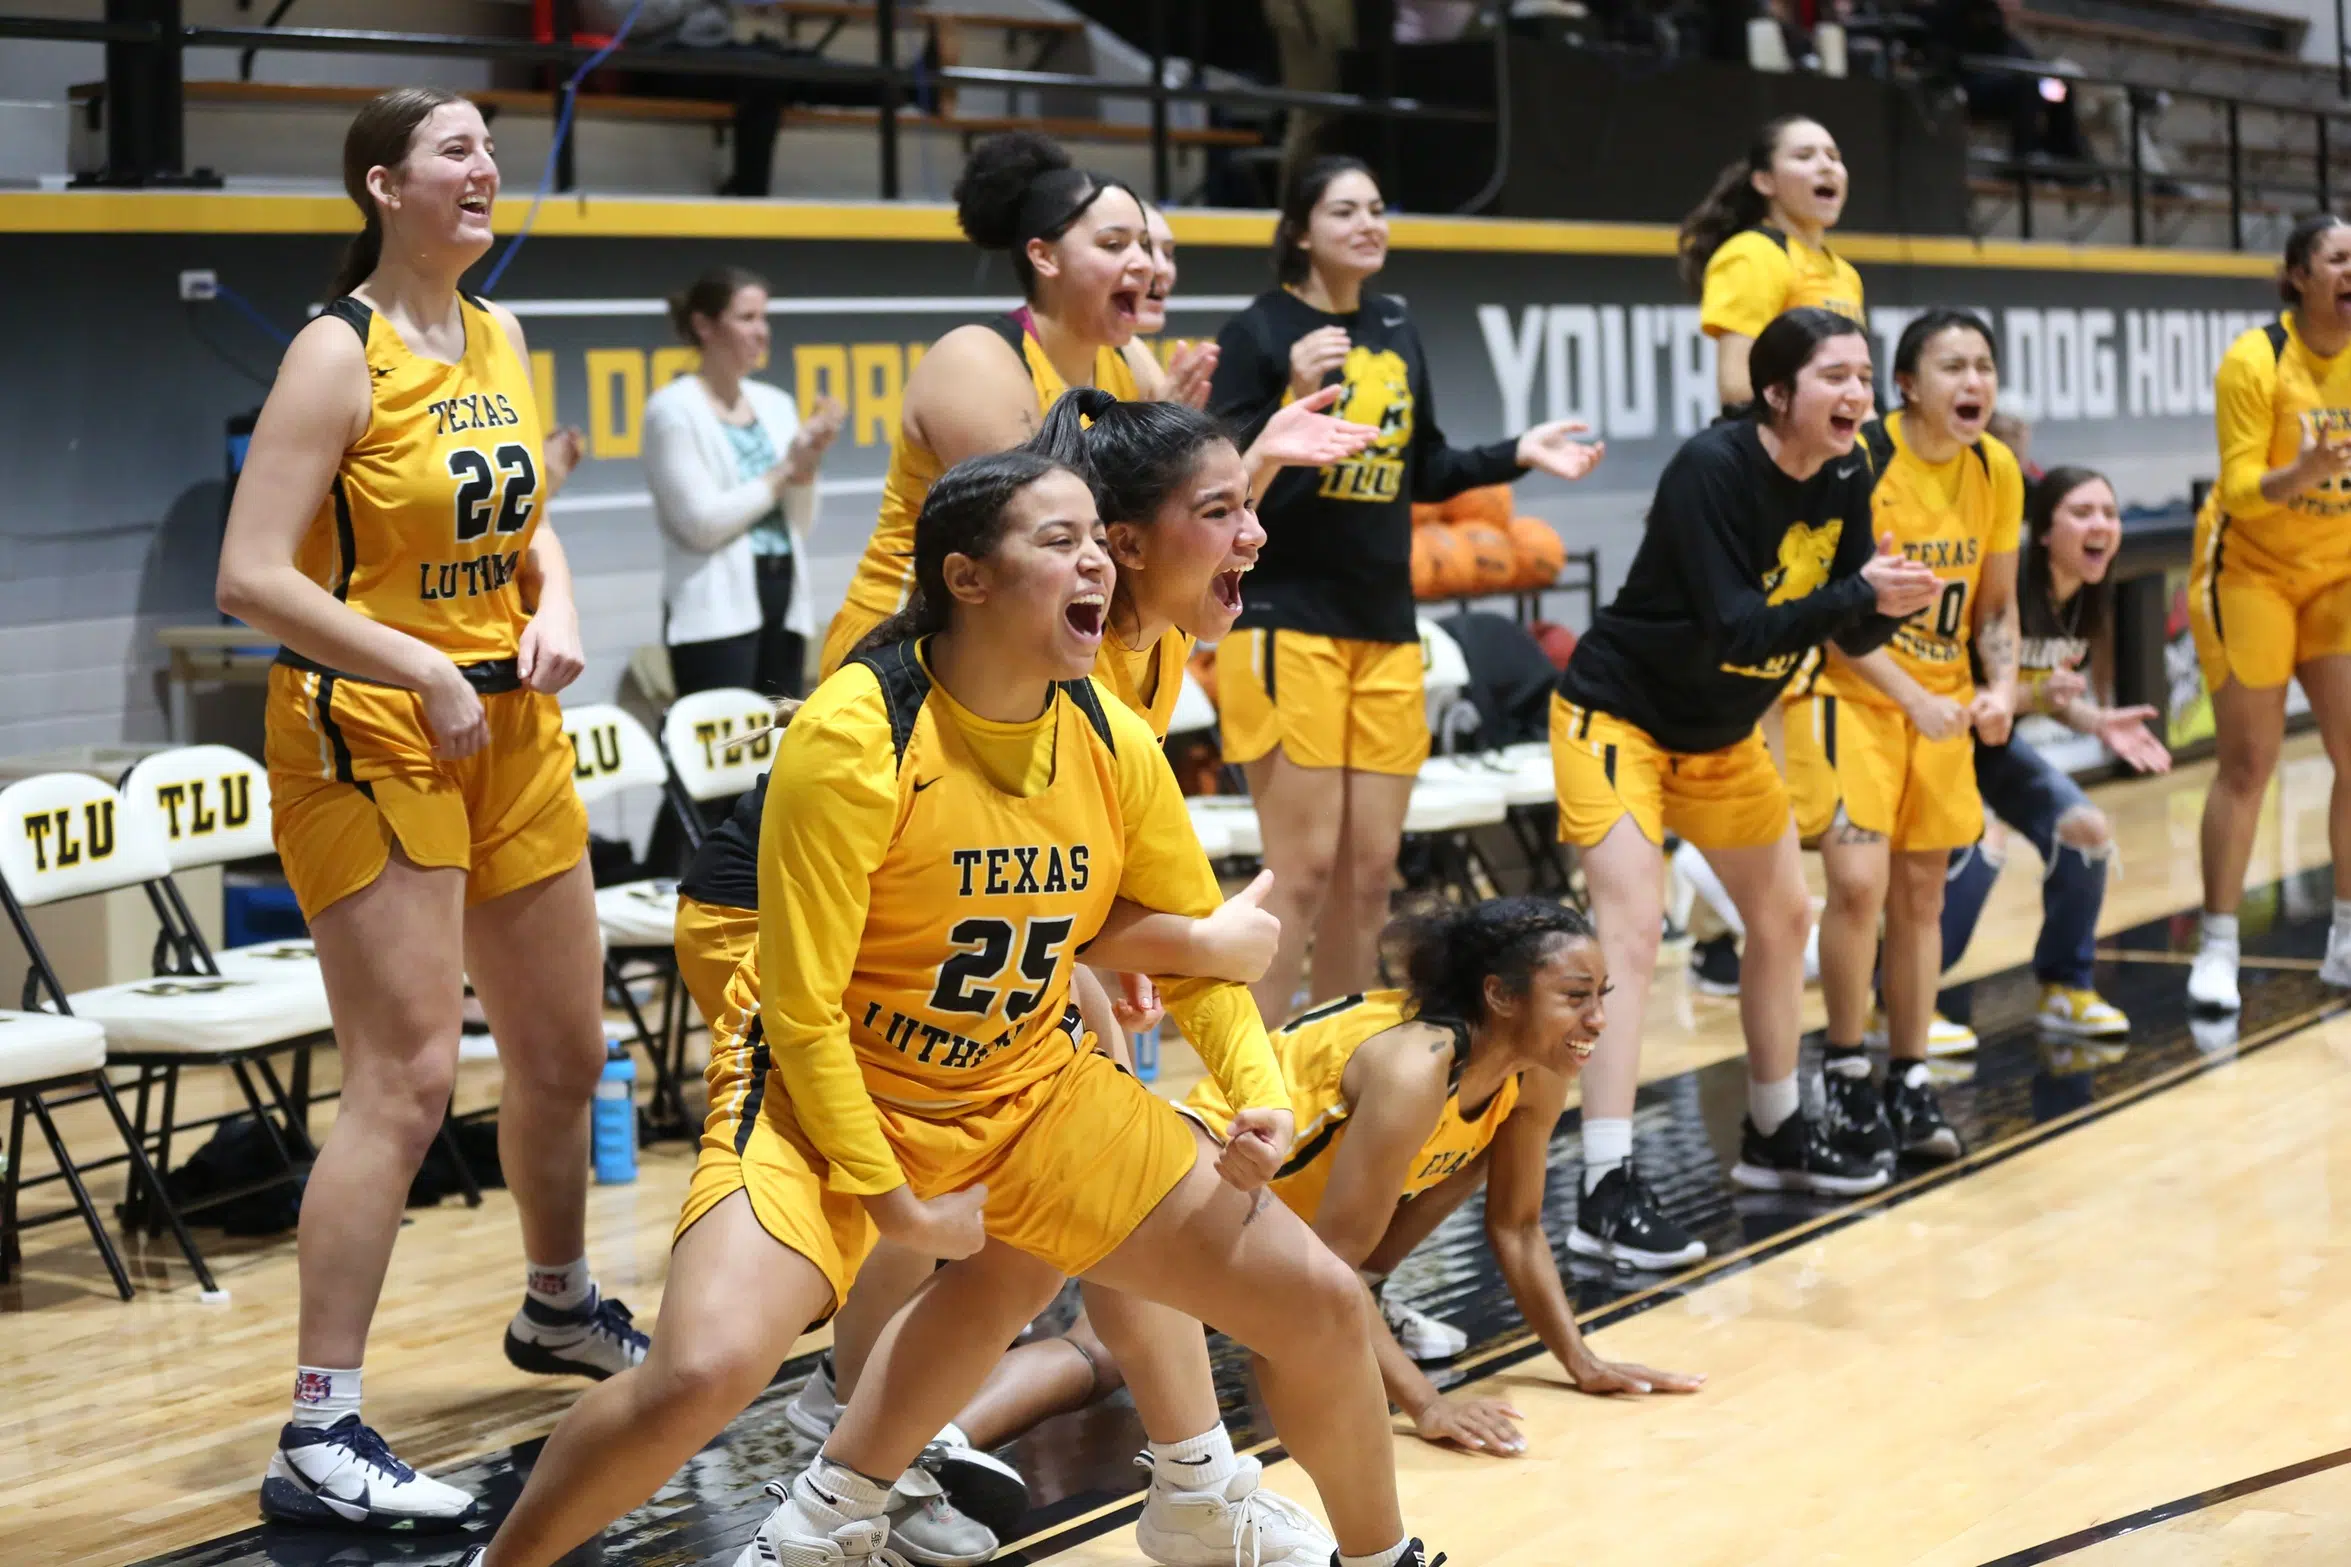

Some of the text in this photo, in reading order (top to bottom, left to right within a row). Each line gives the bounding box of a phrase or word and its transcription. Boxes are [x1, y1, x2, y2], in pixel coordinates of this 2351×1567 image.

[1476, 303, 1720, 441] YOU'R
[2003, 306, 2118, 421] DOG
[2124, 308, 2277, 418] HOU
[428, 393, 519, 435] TEXAS
[446, 442, 538, 543] 22
[1319, 459, 1404, 502] TLU
[1902, 538, 1978, 568] TEXAS
[570, 722, 621, 779] LU
[692, 713, 772, 770] TLU
[155, 772, 251, 840] TLU
[23, 798, 117, 873] TLU
[952, 844, 1090, 897] TEXAS
[924, 911, 1078, 1026] 25
